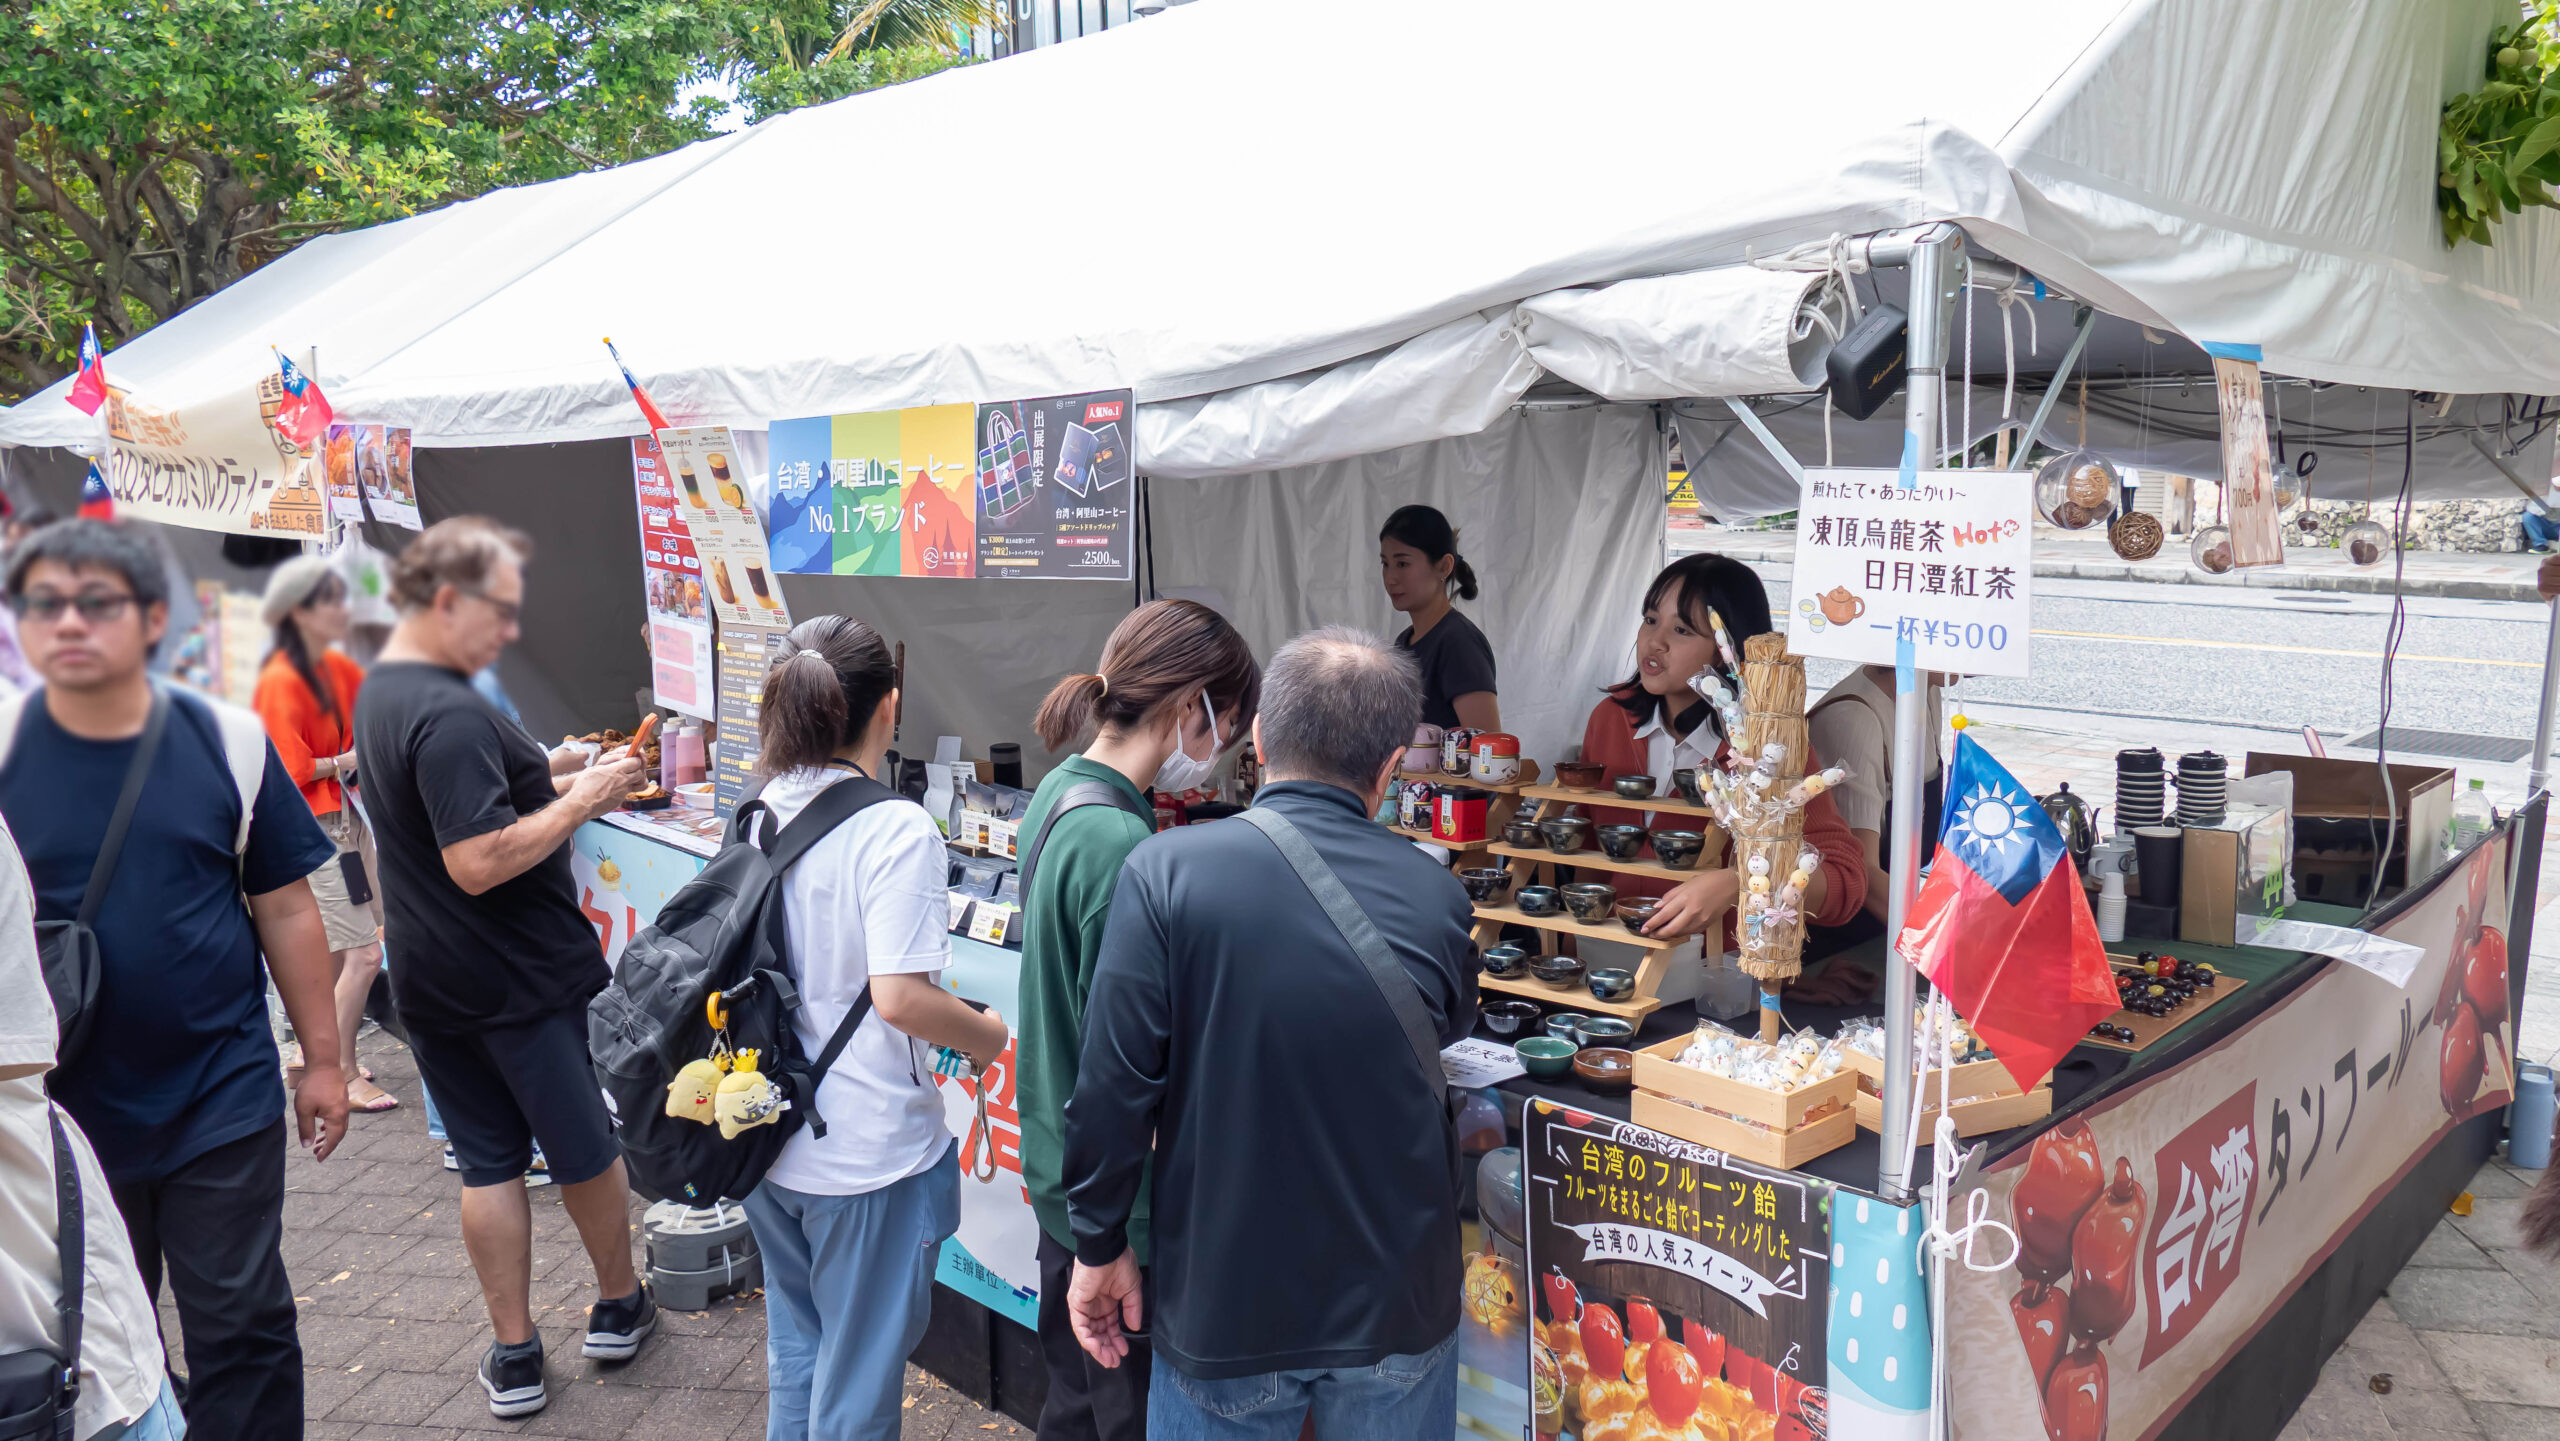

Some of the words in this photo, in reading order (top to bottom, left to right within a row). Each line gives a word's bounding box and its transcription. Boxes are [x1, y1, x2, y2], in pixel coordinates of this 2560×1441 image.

[1088, 406, 1119, 419] 人気No.1
[1032, 409, 1045, 488] 出展限定
[777, 454, 965, 491] 台湾・阿里山コーヒー
[1056, 507, 1127, 519] 台湾・阿里山コーヒー
[1809, 515, 1945, 553] 凍頂烏龍茶
[1953, 520, 2002, 548] Hot
[1865, 559, 2016, 600] 日月潭紅茶
[1870, 615, 2008, 651] 一杯¥500
[1581, 1138, 1777, 1221] 台湾のフルーツ飴
[2155, 1124, 2255, 1334] 台湾
[2257, 997, 2435, 1227] タンフールー
[1563, 1174, 1791, 1261] フルーツをまるごと飴でコーティングした
[1592, 1226, 1755, 1294] 台湾の人気スイーツ
